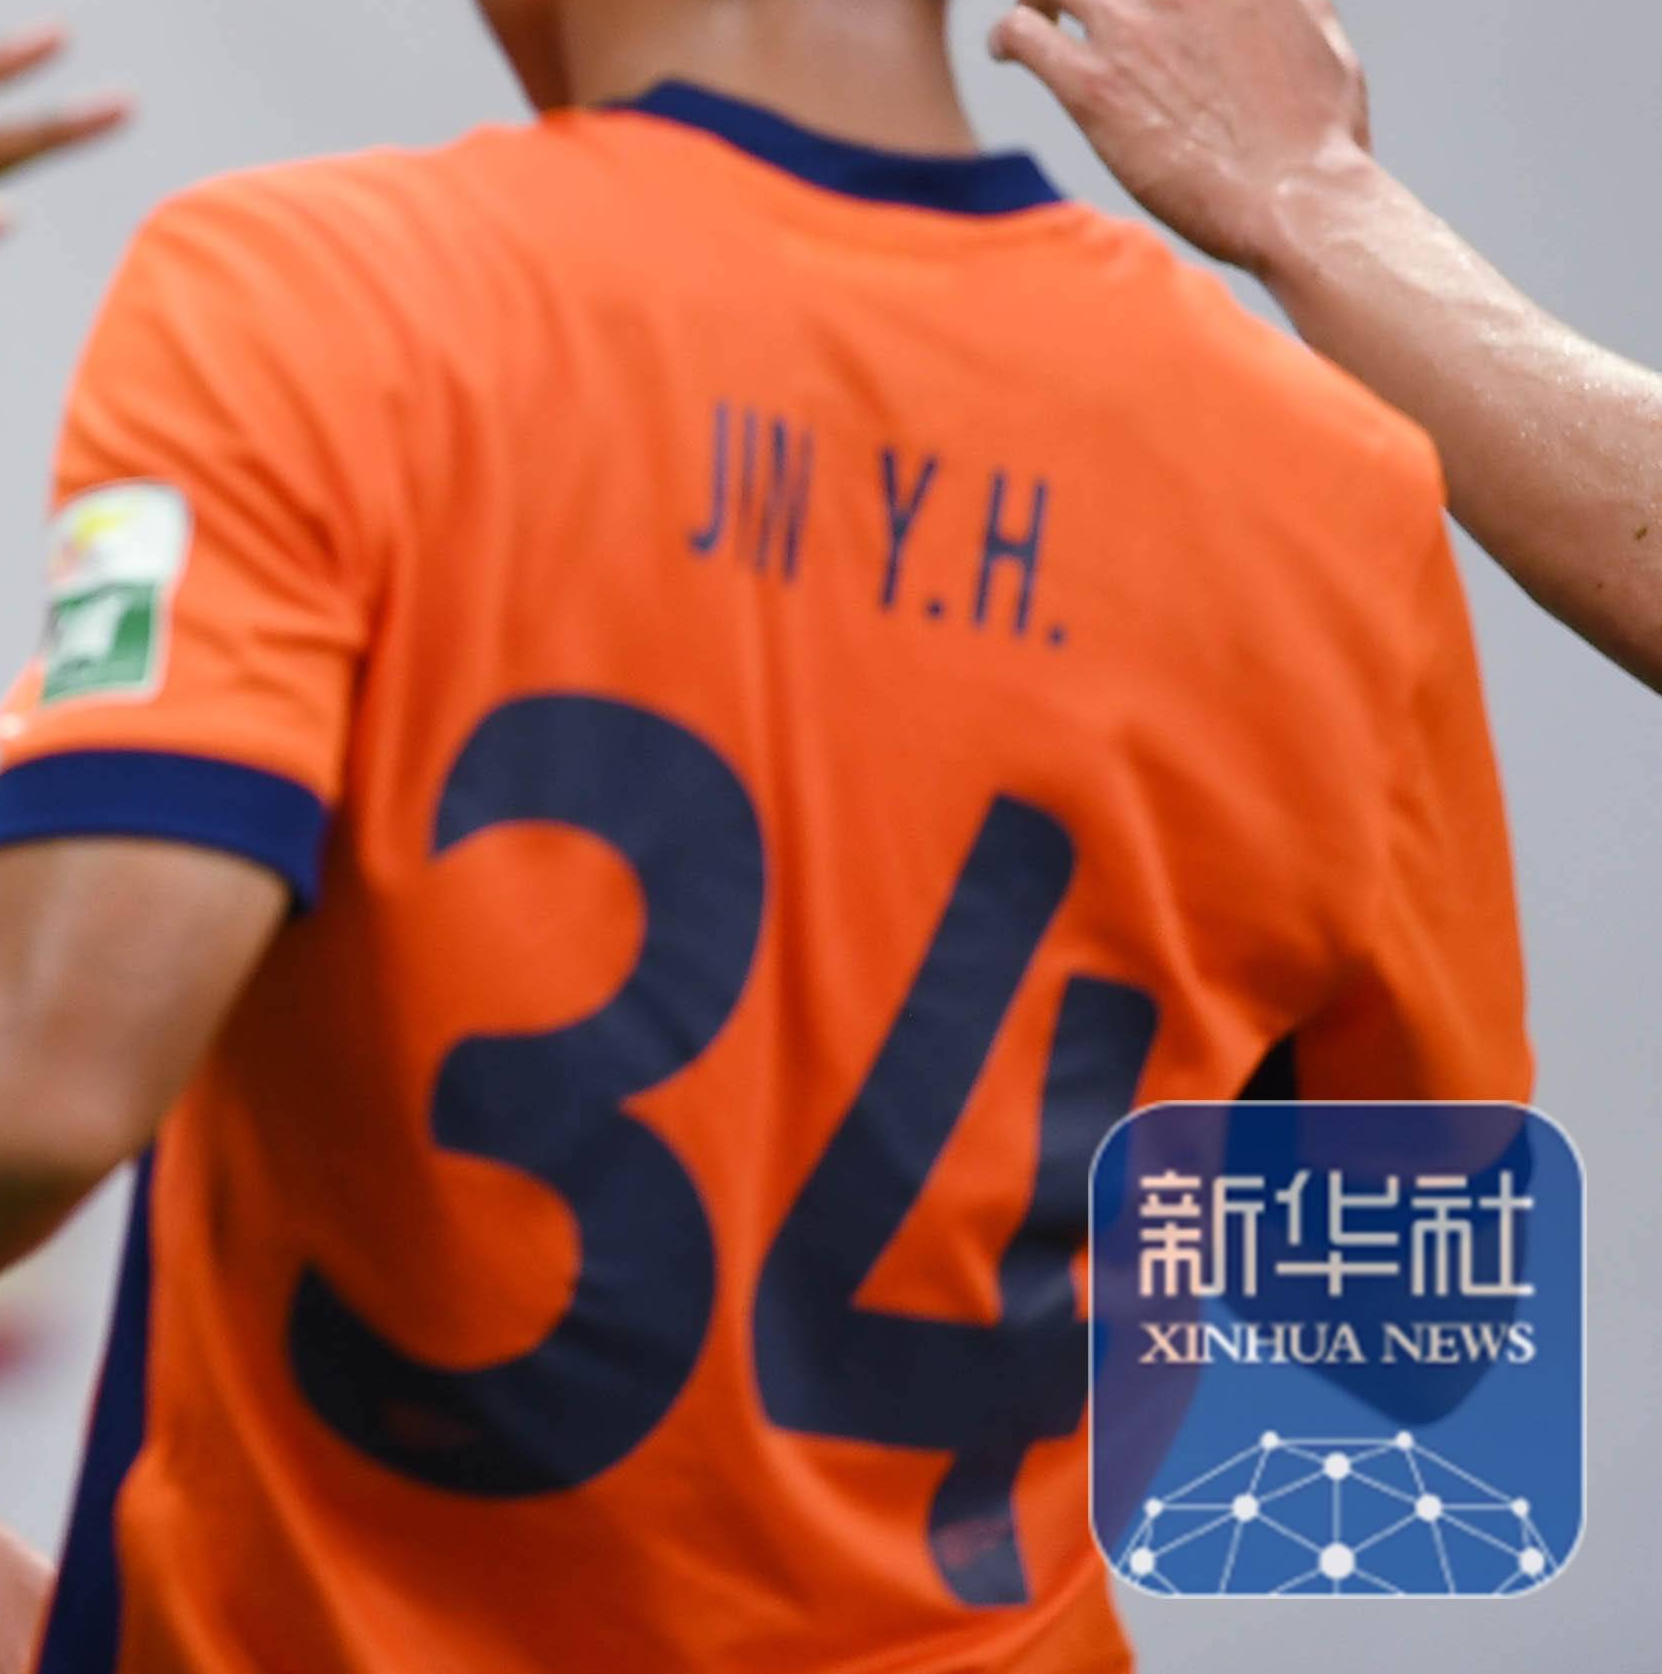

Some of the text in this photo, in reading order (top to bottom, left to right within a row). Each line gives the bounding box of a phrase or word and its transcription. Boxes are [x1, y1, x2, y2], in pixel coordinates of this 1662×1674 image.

[688, 401, 1072, 649] JIN Y.H.
[290, 692, 1158, 1606] 34
